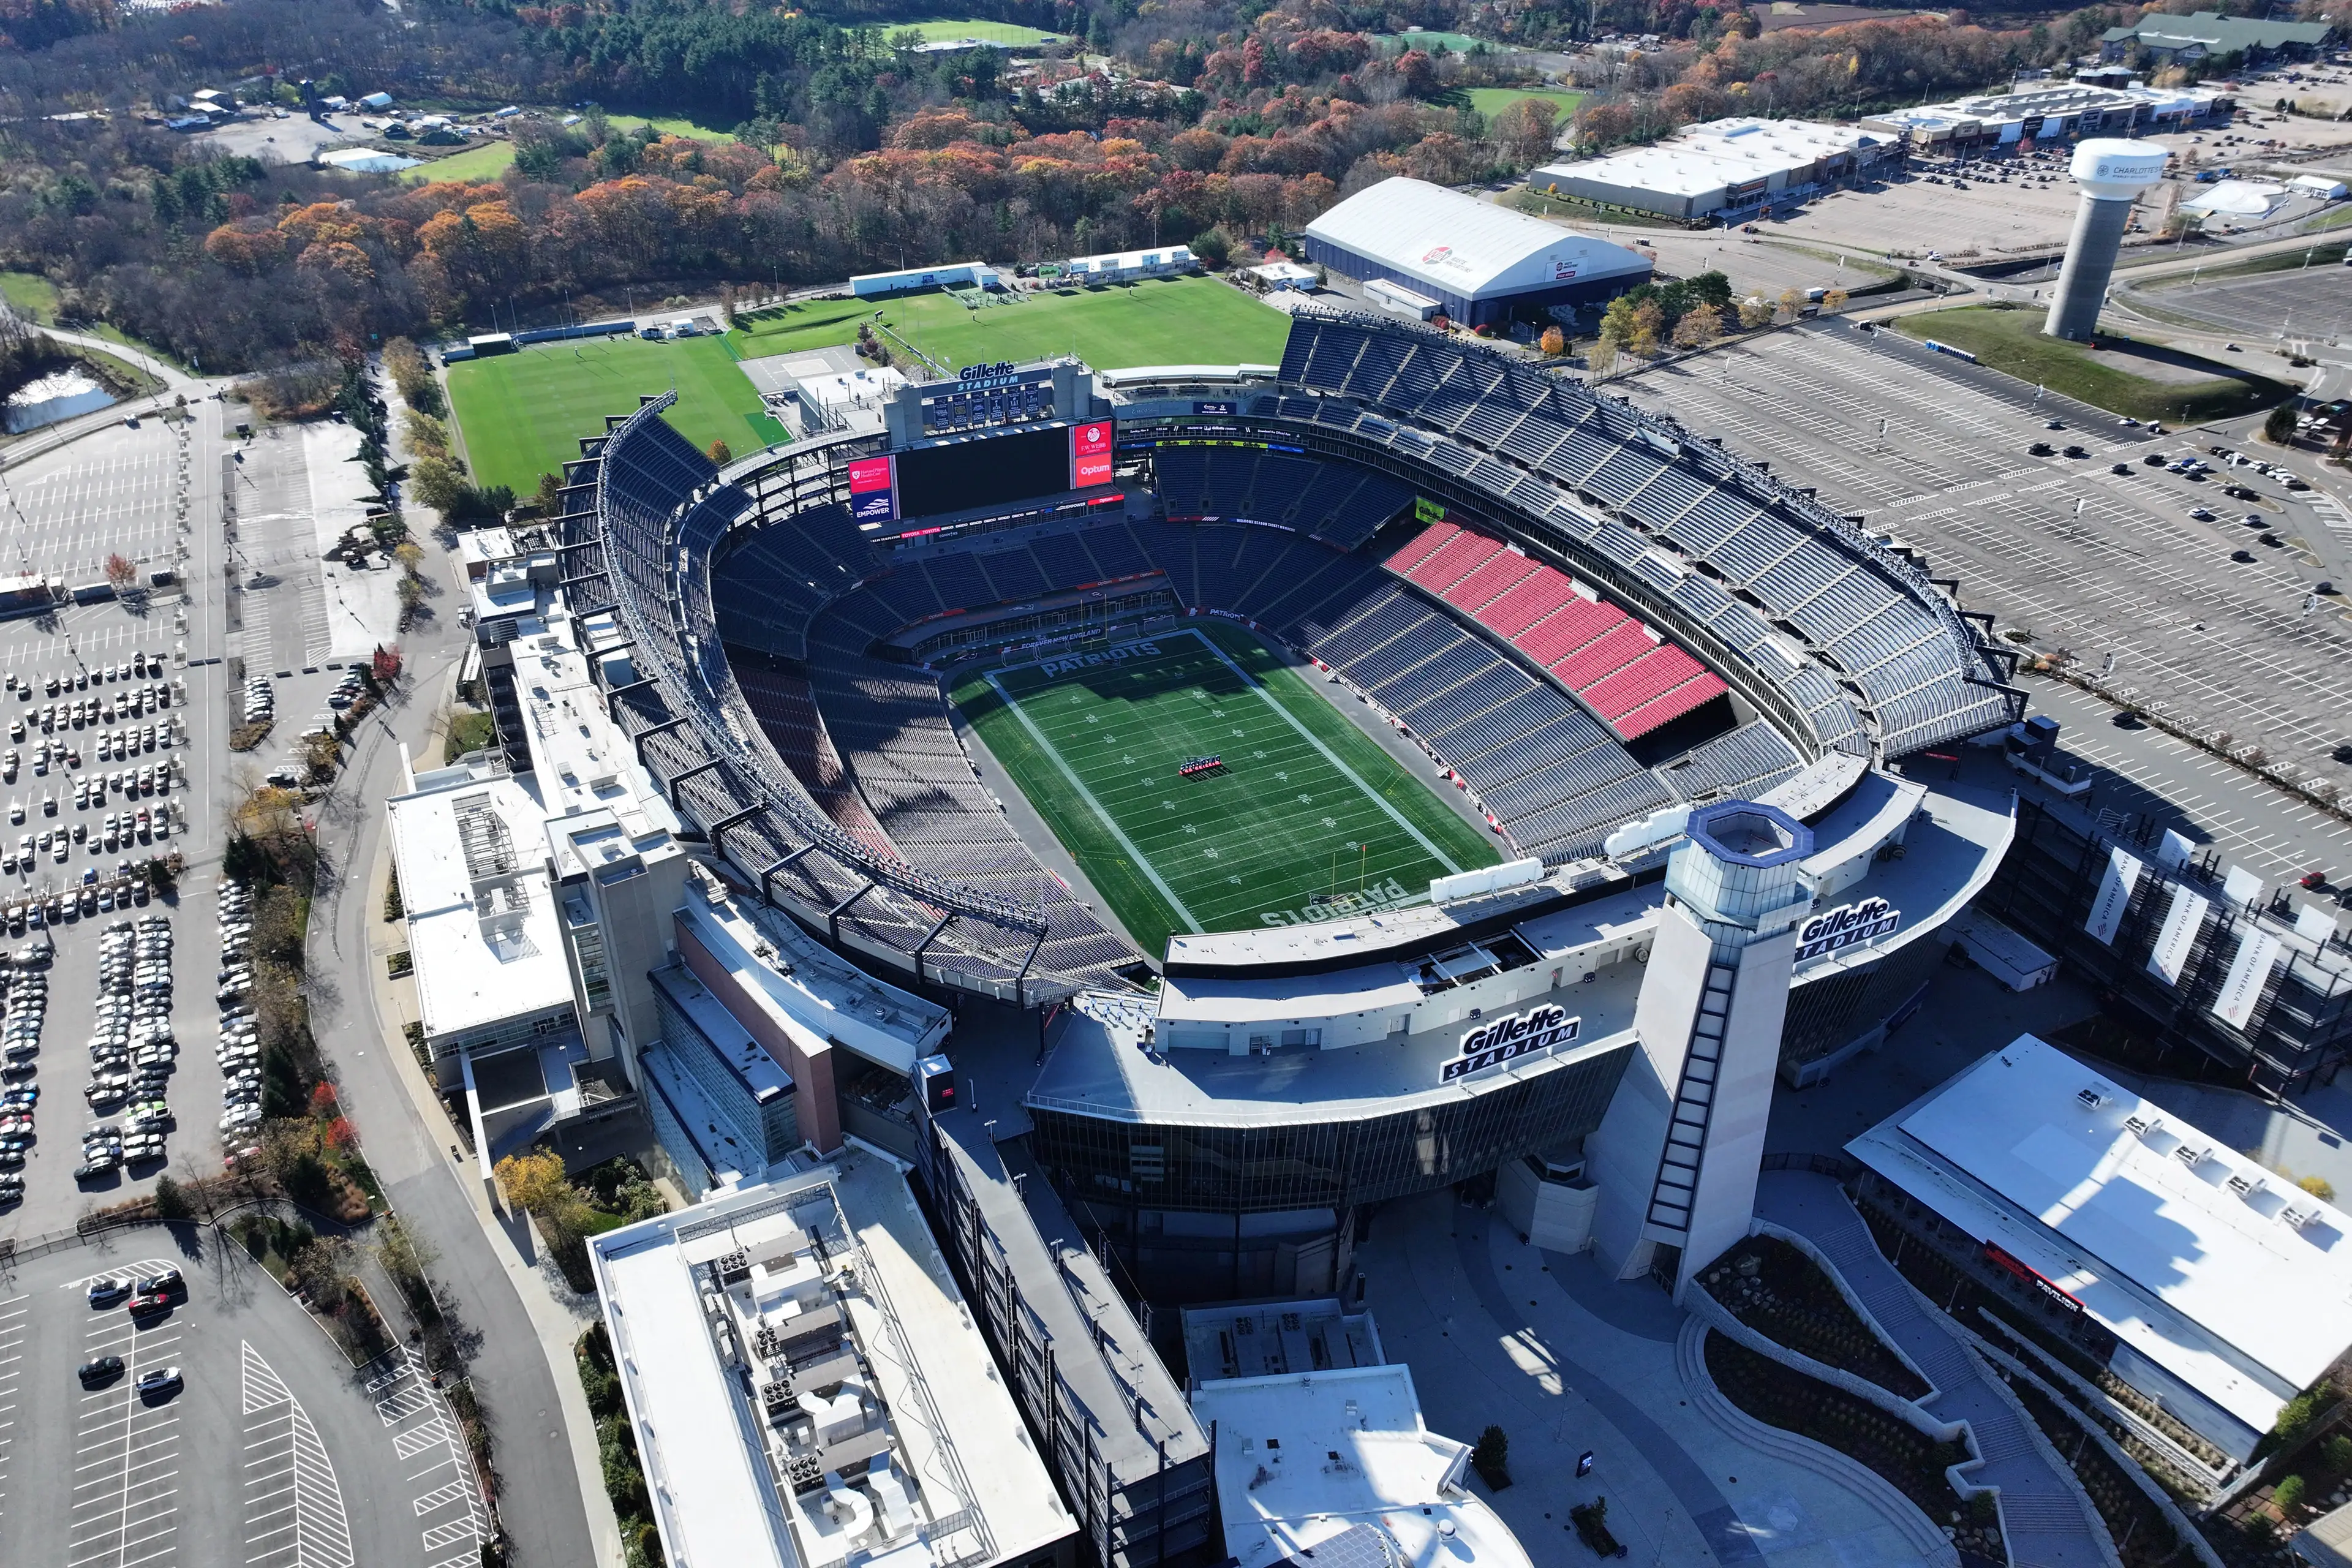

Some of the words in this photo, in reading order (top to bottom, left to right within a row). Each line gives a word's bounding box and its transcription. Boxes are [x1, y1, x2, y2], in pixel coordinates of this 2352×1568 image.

[960, 361, 1014, 380] Gillette
[957, 375, 1018, 391] STADIUM
[1081, 464, 1110, 476] Optum
[856, 507, 889, 518] EMPOWER
[1022, 638, 1053, 649] FOREVER
[1053, 634, 1069, 644] NEW
[1069, 628, 1101, 641] ENGLAND
[1041, 643, 1162, 678] PATRIOTS
[1085, 715, 1098, 723] 20
[1104, 734, 1117, 743] 30
[1141, 777, 1155, 786] 50
[1182, 823, 1196, 833] 30
[1203, 848, 1218, 858] 20
[2118, 854, 2130, 876] BANK
[2114, 876, 2122, 888] OF
[1259, 876, 1409, 926] PATRIOTS
[2101, 886, 2117, 919] AMERICA
[2184, 892, 2195, 914] BANK
[1803, 901, 1888, 943] Gillette
[2179, 915, 2187, 926] OF
[1796, 918, 1893, 959] TADIUM
[2165, 925, 2182, 960] AMERICA
[2253, 933, 2266, 956] BANK
[2248, 957, 2257, 968] OF
[2233, 967, 2253, 1001] AMERICA
[1463, 1008, 1564, 1055] Gillette
[1449, 1025, 1574, 1078] STADIUM
[2035, 1279, 2079, 1313] PAVILION
